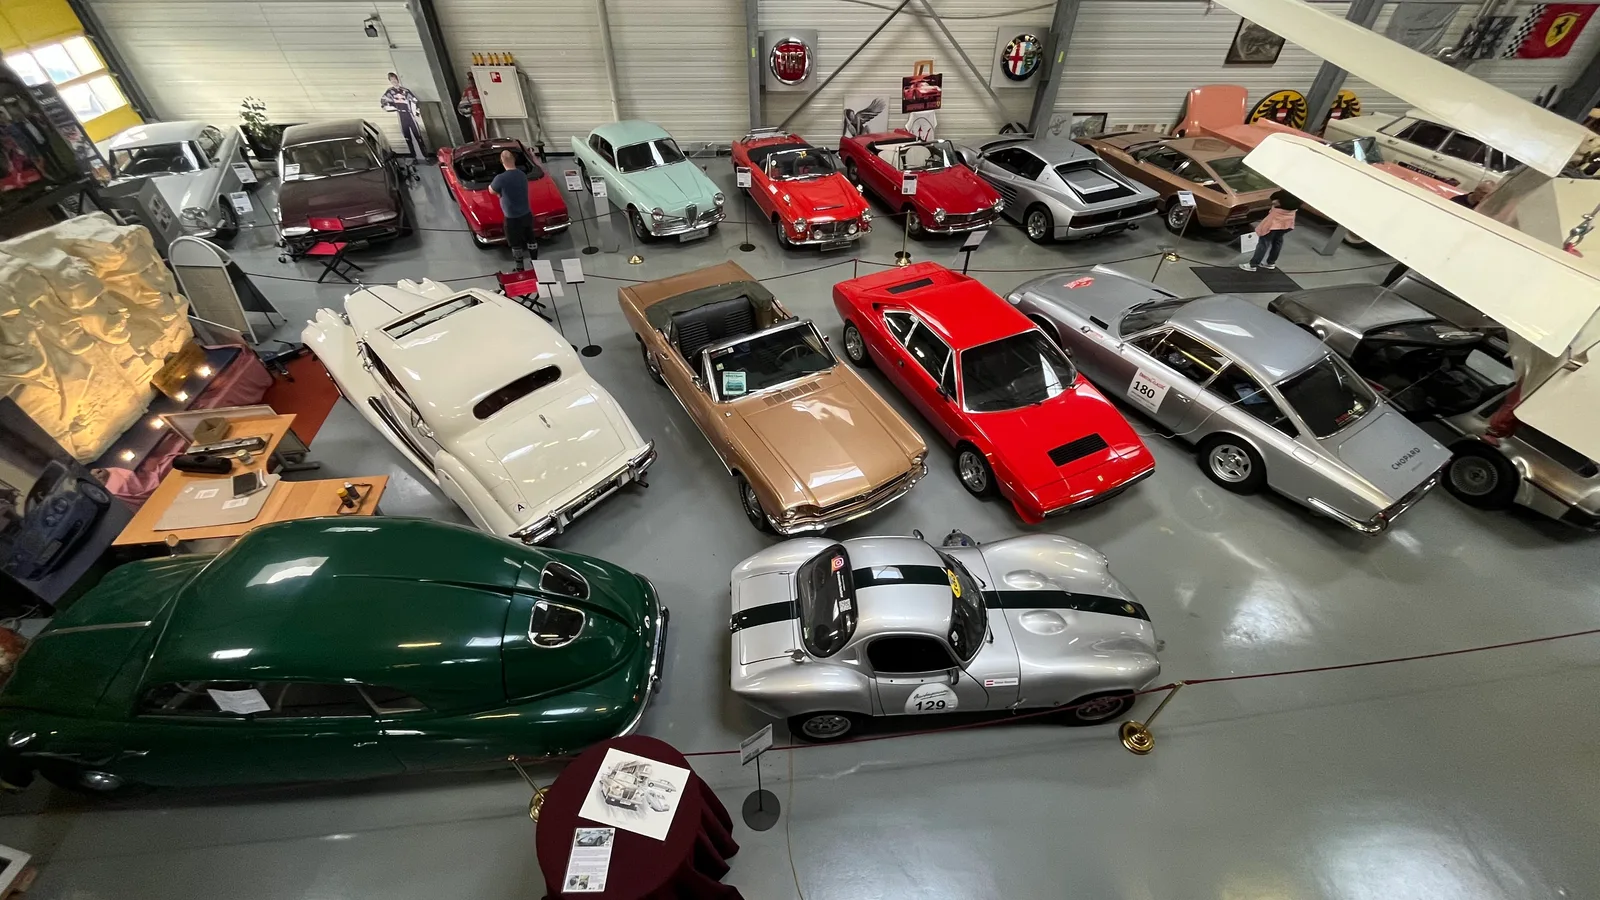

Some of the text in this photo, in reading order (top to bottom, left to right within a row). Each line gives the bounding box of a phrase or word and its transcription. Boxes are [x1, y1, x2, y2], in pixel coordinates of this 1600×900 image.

[1133, 381, 1155, 399] 180
[1391, 447, 1421, 470] CHOPARD
[517, 503, 525, 511] A
[914, 700, 946, 711] 129
